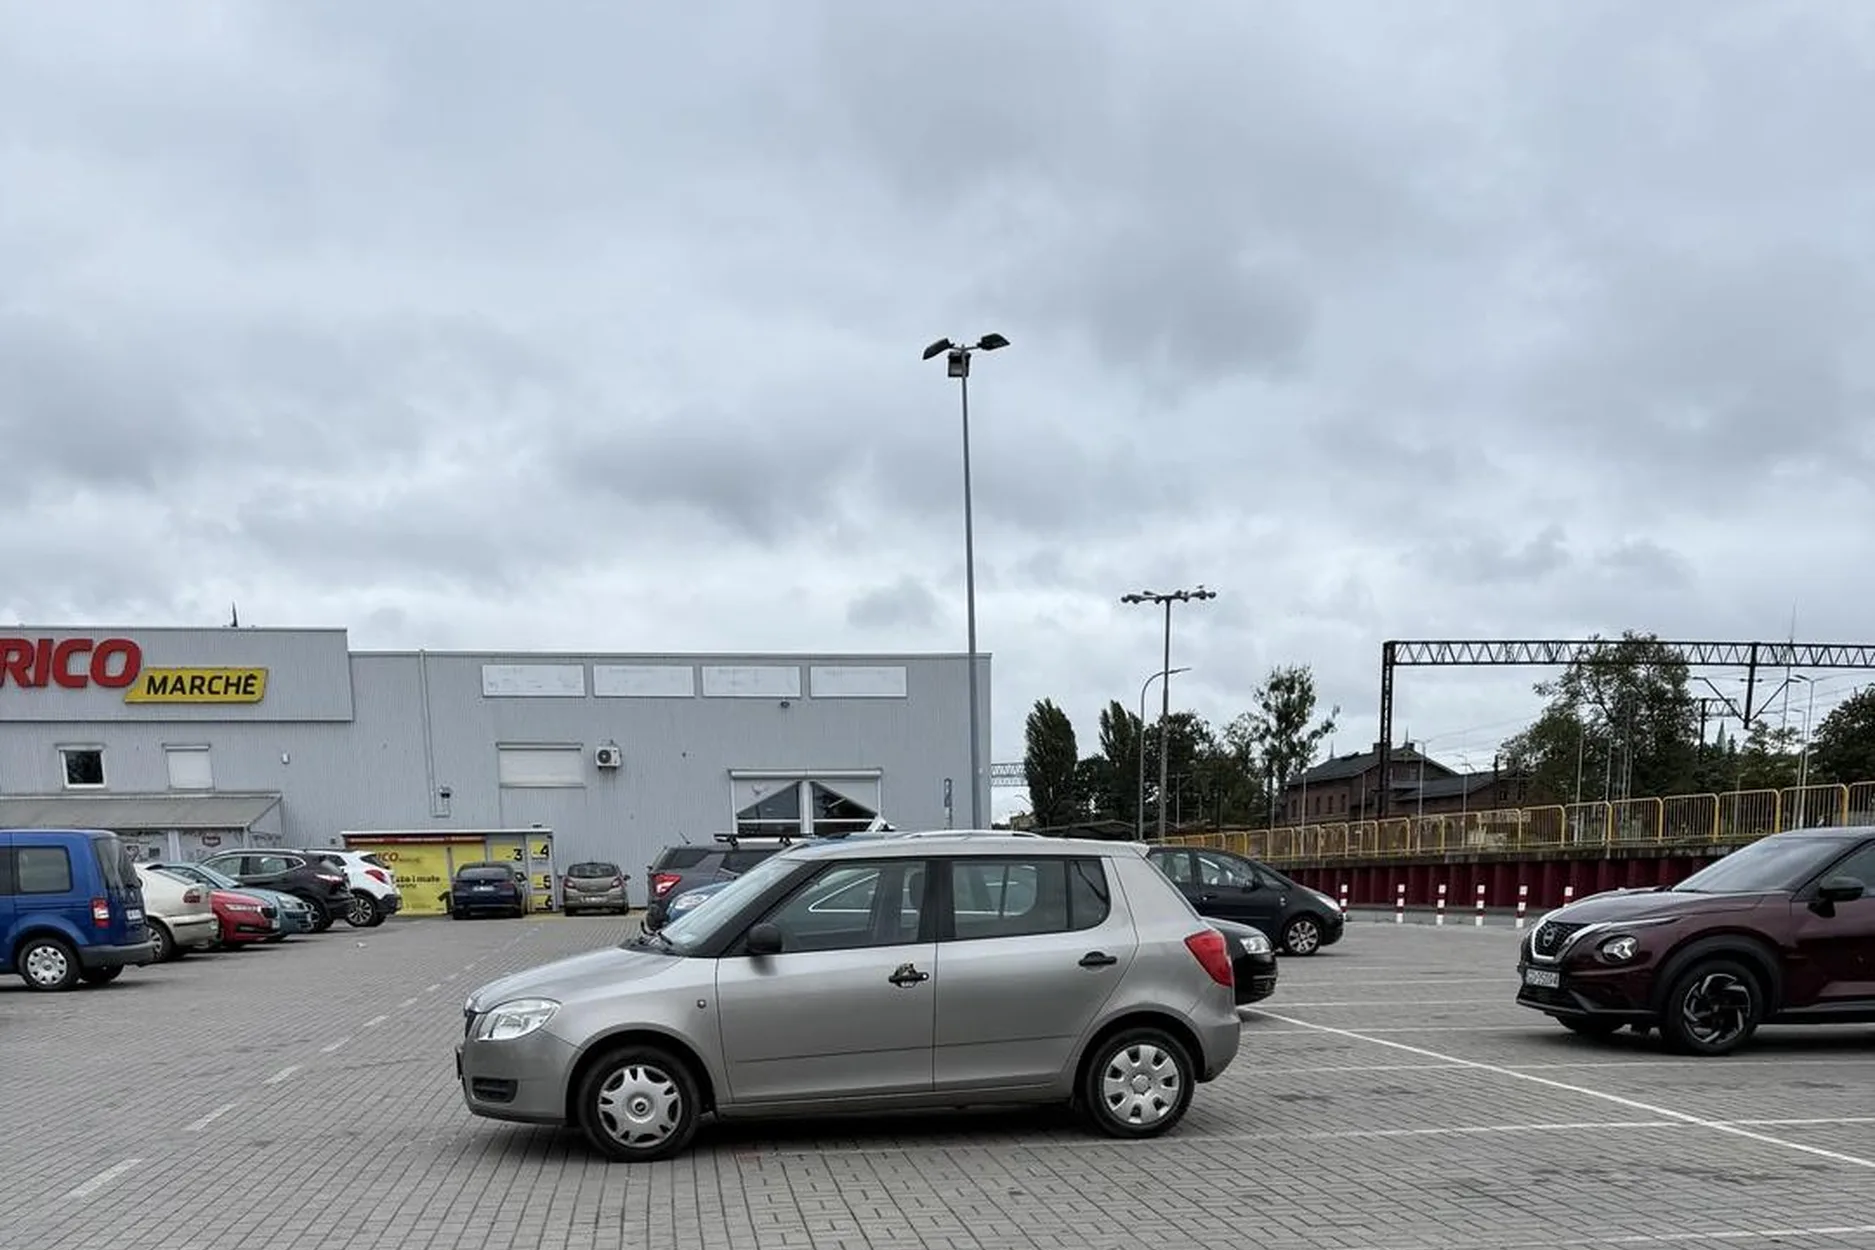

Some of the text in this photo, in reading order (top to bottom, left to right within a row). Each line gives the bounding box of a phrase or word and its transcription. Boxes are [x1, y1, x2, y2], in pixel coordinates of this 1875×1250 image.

[0, 638, 142, 689] RICO
[513, 848, 523, 861] 3
[540, 844, 549, 857] 4
